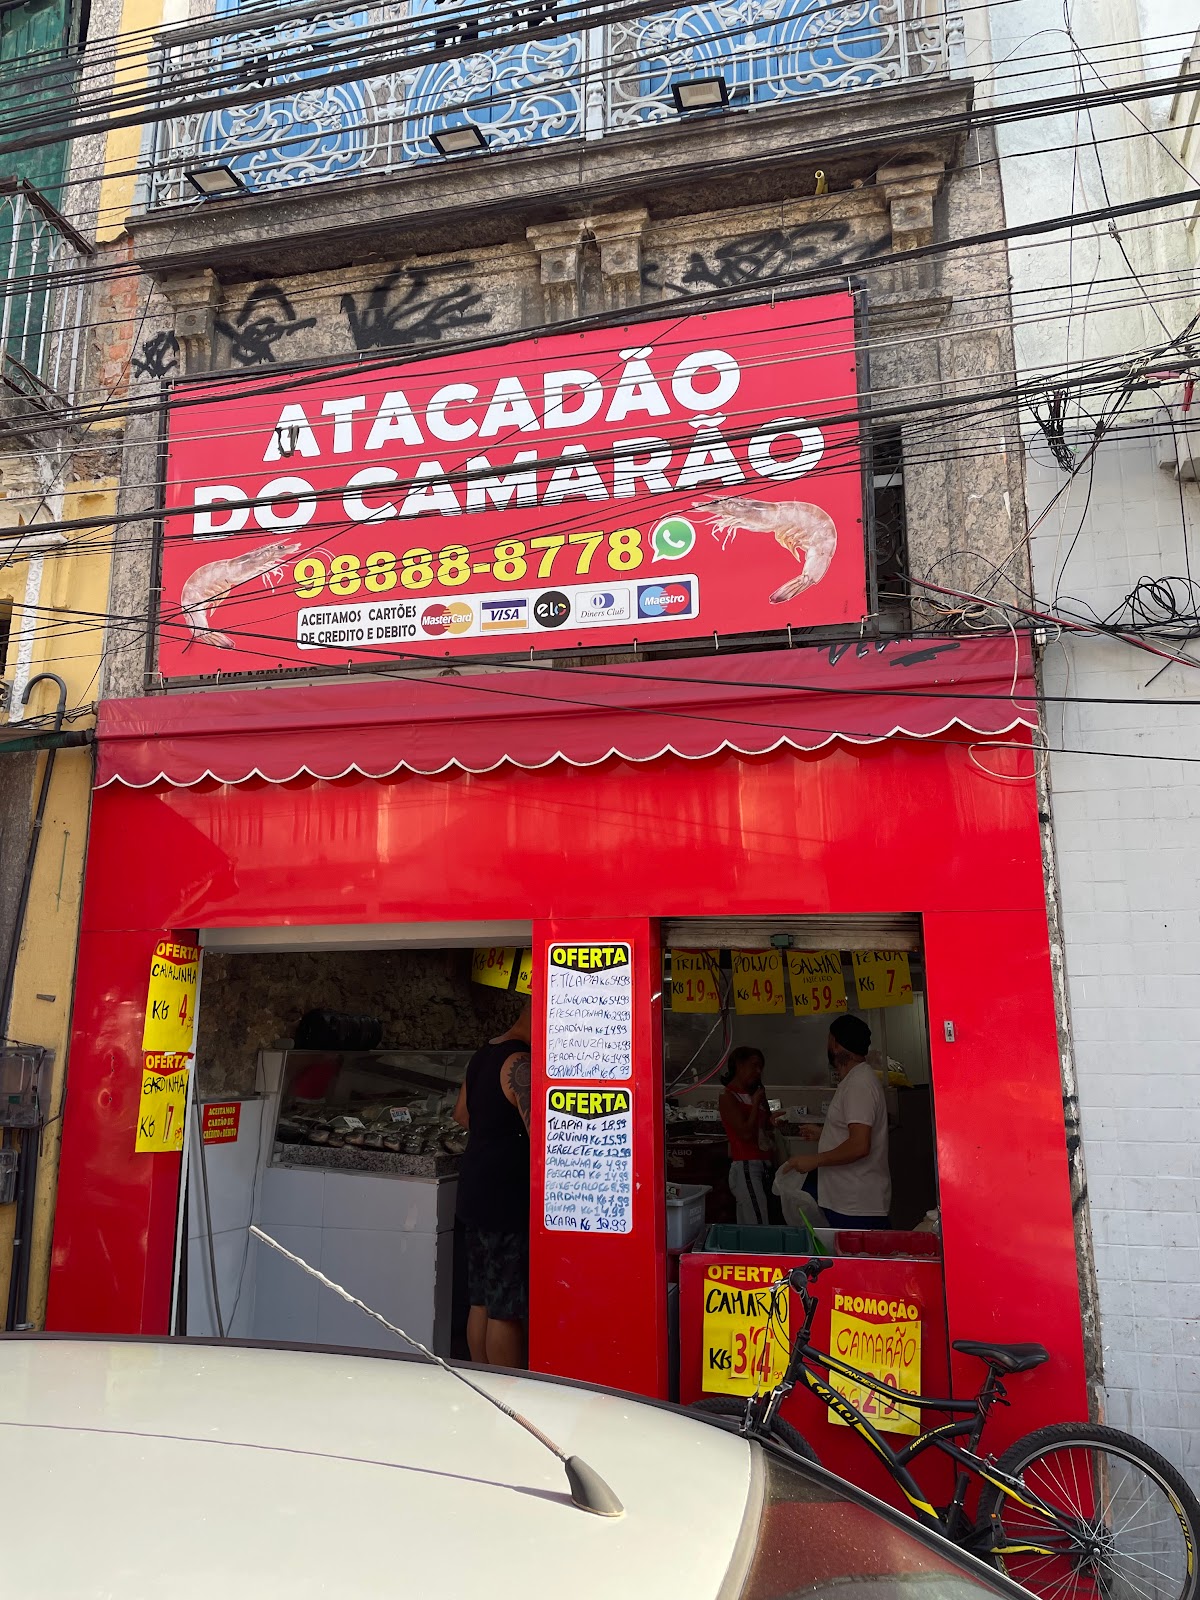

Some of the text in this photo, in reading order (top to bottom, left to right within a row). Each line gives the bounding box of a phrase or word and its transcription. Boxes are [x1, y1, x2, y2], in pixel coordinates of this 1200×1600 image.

[263, 346, 740, 461] ATACADÃO
[193, 412, 825, 541] DO CAMARÃO
[294, 528, 643, 598] 98888-8778
[537, 602, 567, 617] elo
[644, 594, 685, 607] Maestro
[301, 604, 416, 626] ACEITAMOS CARTÕES
[422, 613, 473, 626] MasterCard
[490, 609, 519, 621] VISA
[580, 607, 625, 619] Diners Club
[301, 625, 416, 644] DE CREDITO E DEBITO
[156, 942, 198, 961] OFERTA
[552, 947, 627, 968] OFERTA
[145, 1055, 188, 1069] OFERTA
[144, 1075, 185, 1095] SARDINHA
[550, 1092, 628, 1114] OFERTA
[707, 1265, 785, 1284] OFERTA
[834, 1293, 919, 1322] PROMOÇÃO
[836, 1325, 917, 1368] CAMARÃO
